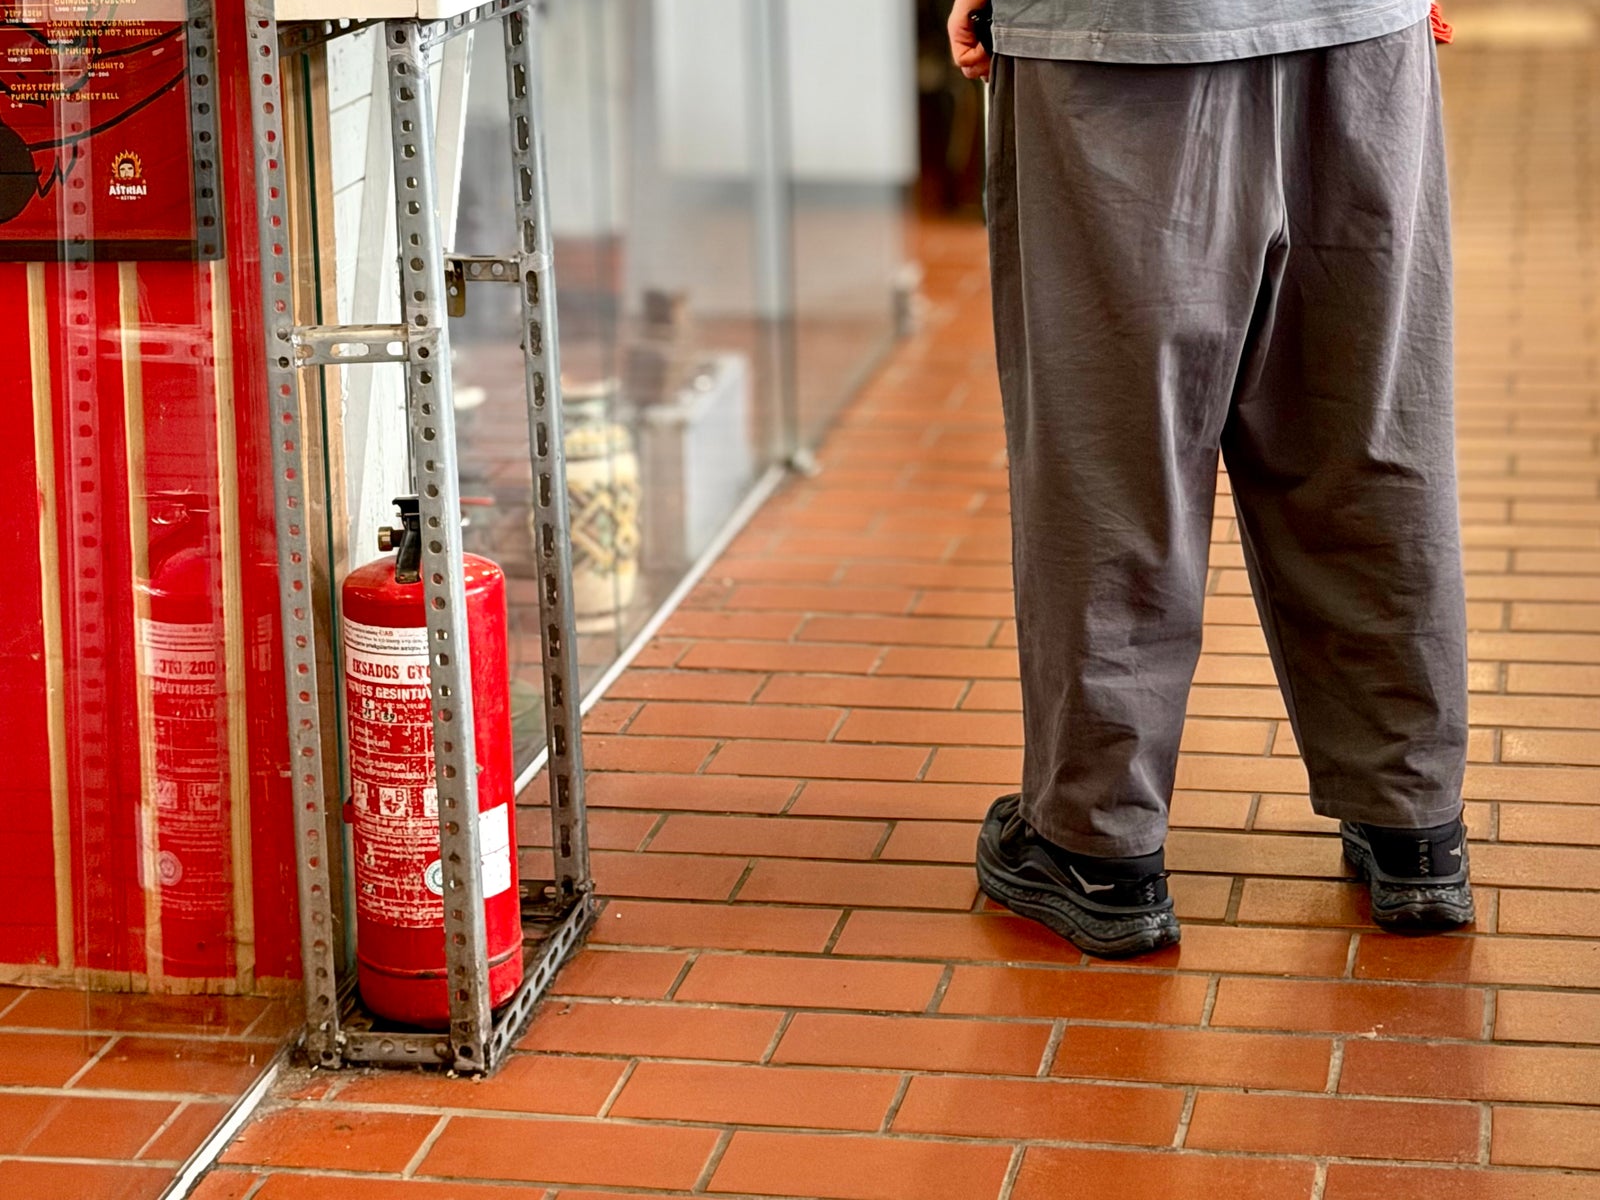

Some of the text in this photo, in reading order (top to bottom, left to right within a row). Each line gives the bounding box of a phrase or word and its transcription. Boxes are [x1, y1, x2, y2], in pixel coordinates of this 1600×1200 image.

[47, 28, 163, 38] ITALIAN LONG HOT, MEXIBELL
[87, 62, 125, 70] SHISHITO
[10, 83, 36, 91] GYPSY
[11, 93, 39, 101] PURPLE
[75, 92, 100, 101] SWEET
[101, 92, 119, 100] BELL
[394, 789, 405, 803] B
